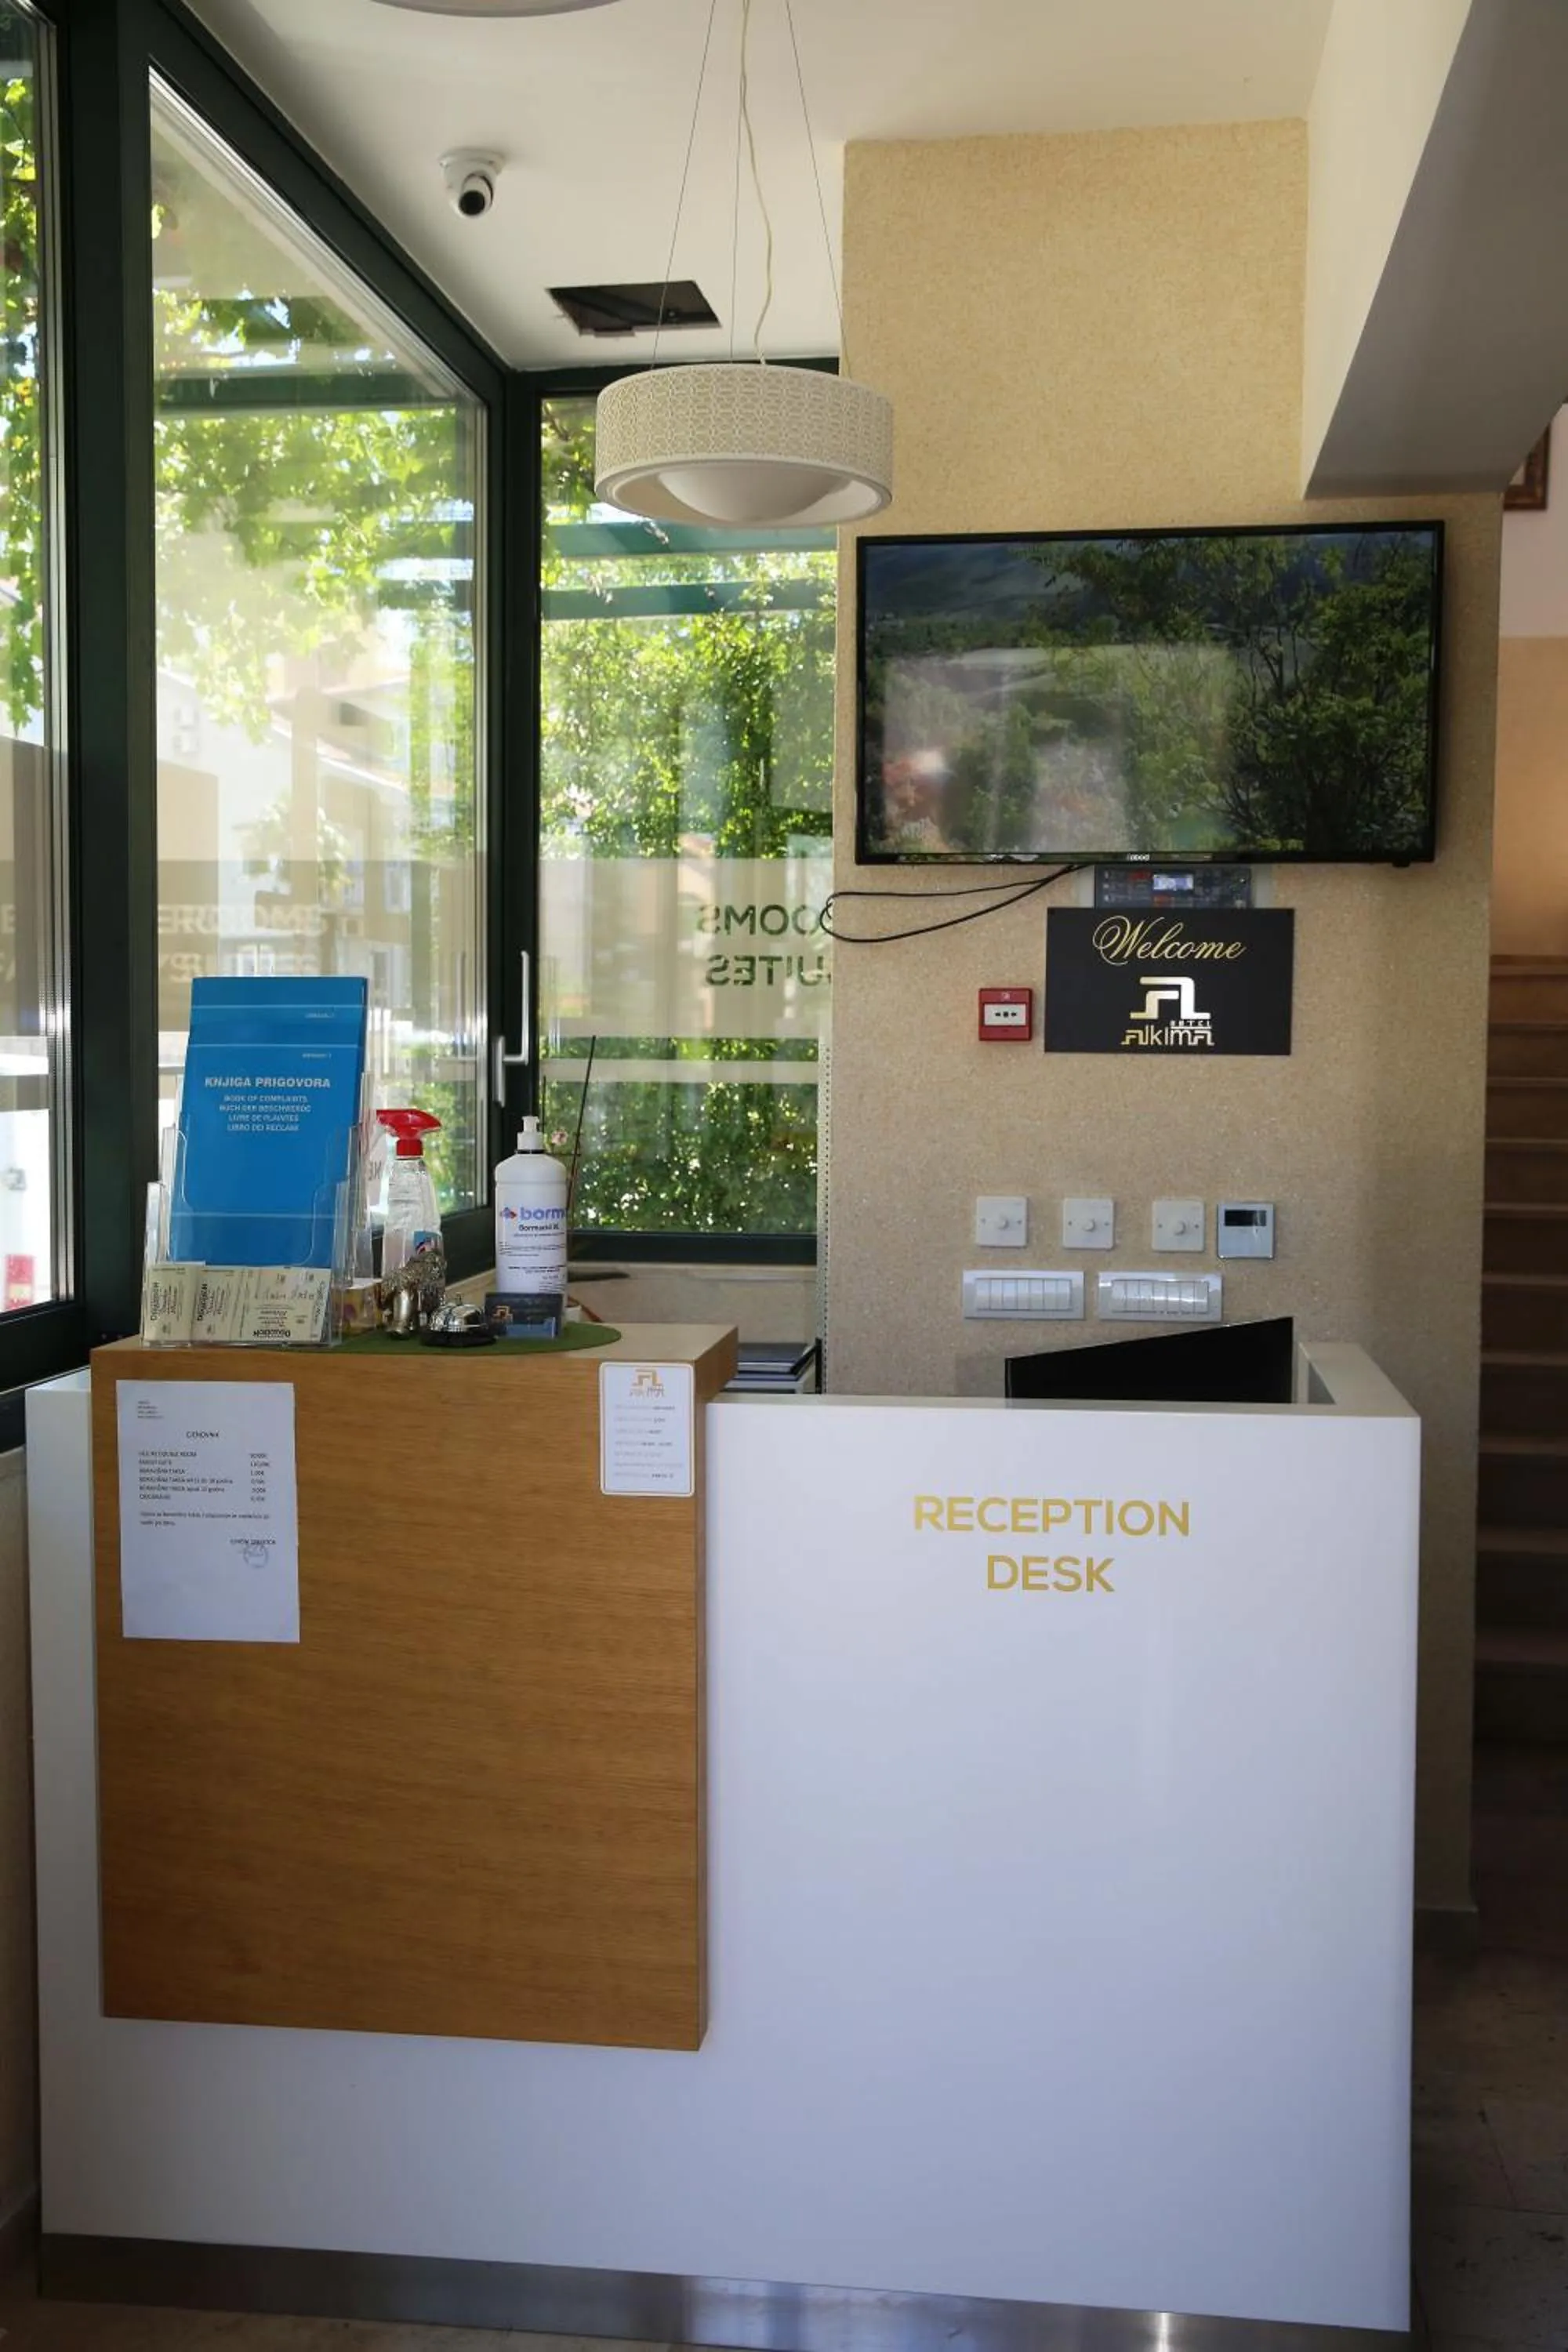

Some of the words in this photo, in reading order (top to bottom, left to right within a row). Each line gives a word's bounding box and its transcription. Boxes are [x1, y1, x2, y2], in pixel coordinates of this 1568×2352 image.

[1092, 915, 1247, 966] Welcome
[205, 1076, 251, 1087] KNJIGA
[255, 1077, 330, 1088] PRIGOVORA
[913, 1495, 1189, 1537] RECEPTION
[987, 1555, 1115, 1592] DESK
